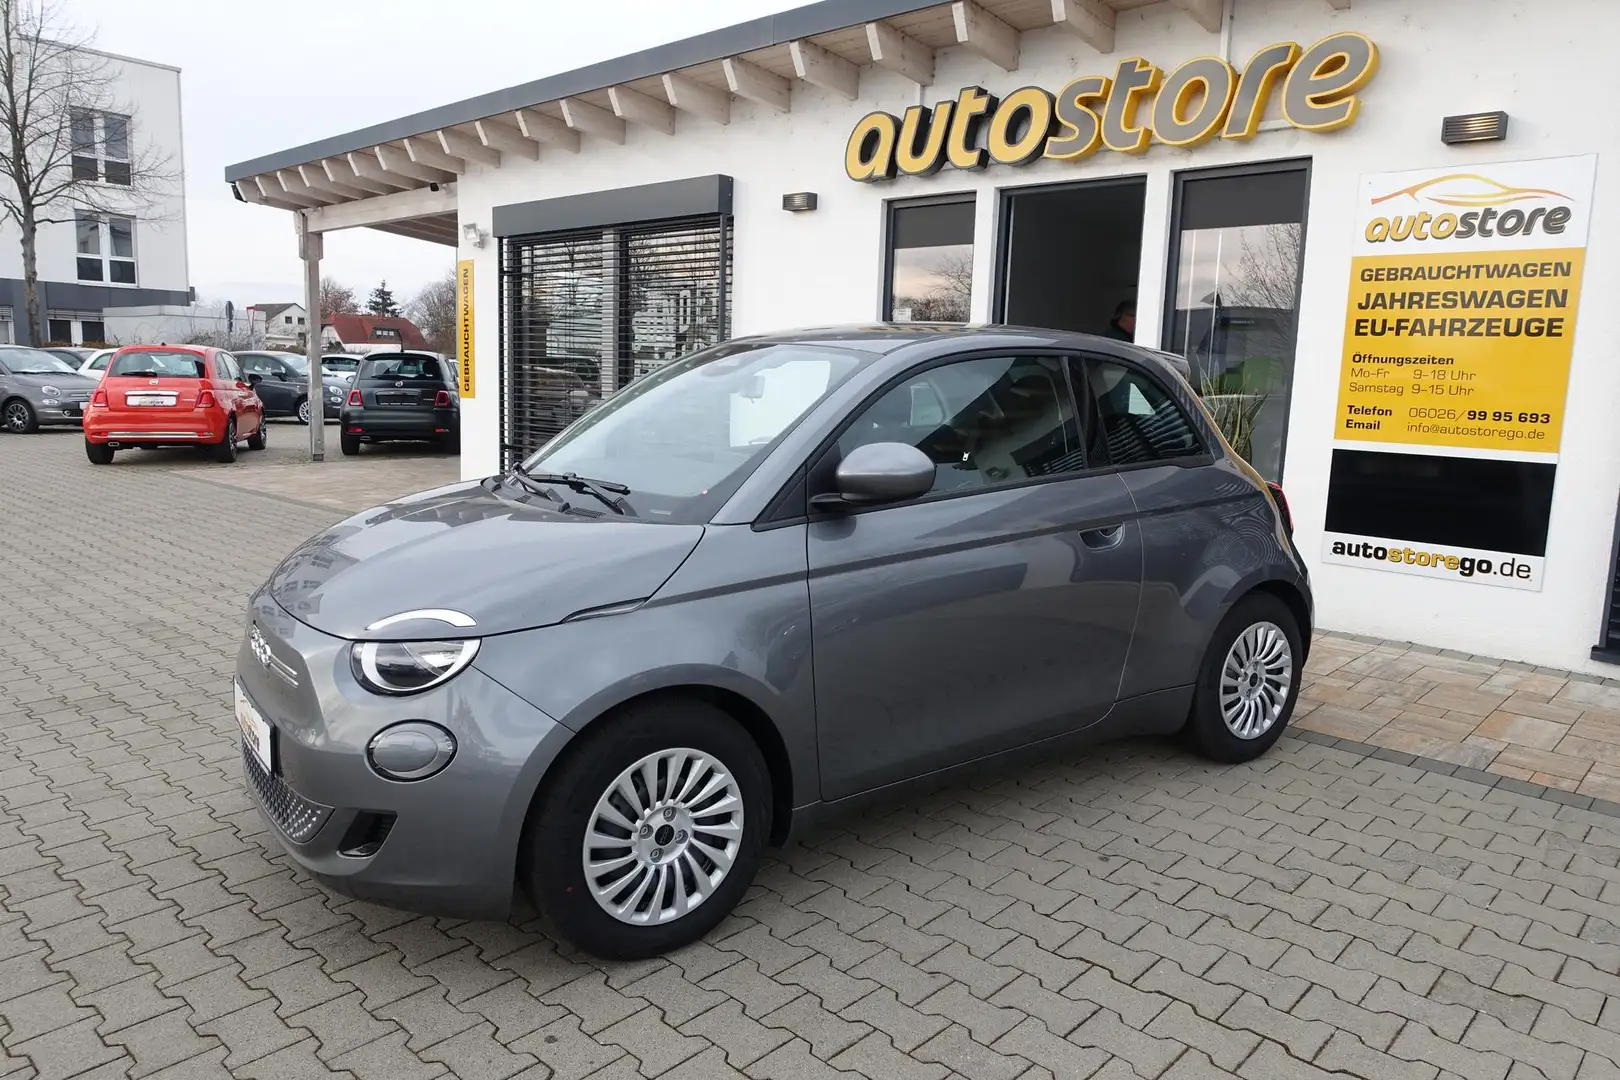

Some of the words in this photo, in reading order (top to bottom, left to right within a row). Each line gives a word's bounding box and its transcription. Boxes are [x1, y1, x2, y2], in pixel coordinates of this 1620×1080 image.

[845, 31, 1381, 183] autostore
[1365, 206, 1572, 243] autostore
[1360, 261, 1572, 282] GEBRAUCHTWAGEN
[1357, 289, 1569, 310] JAHRESWAGEN
[1354, 317, 1565, 338] EU-FAHRZEUGE
[1352, 352, 1455, 367] Öffnungszeiten
[1350, 367, 1390, 379] Mo-Fr
[1412, 369, 1447, 381] 9-18
[1450, 369, 1477, 382] Uhr
[1349, 382, 1404, 396] Samstag
[1411, 384, 1445, 395] 9-15
[1448, 385, 1475, 396] Uhr
[1347, 405, 1393, 417] Telefon
[1492, 410, 1513, 422] 95
[1517, 412, 1551, 424] 693
[1345, 419, 1381, 430] Email
[1407, 422, 1545, 440] info@autostorego.de
[1332, 541, 1531, 579] autostorego.de
